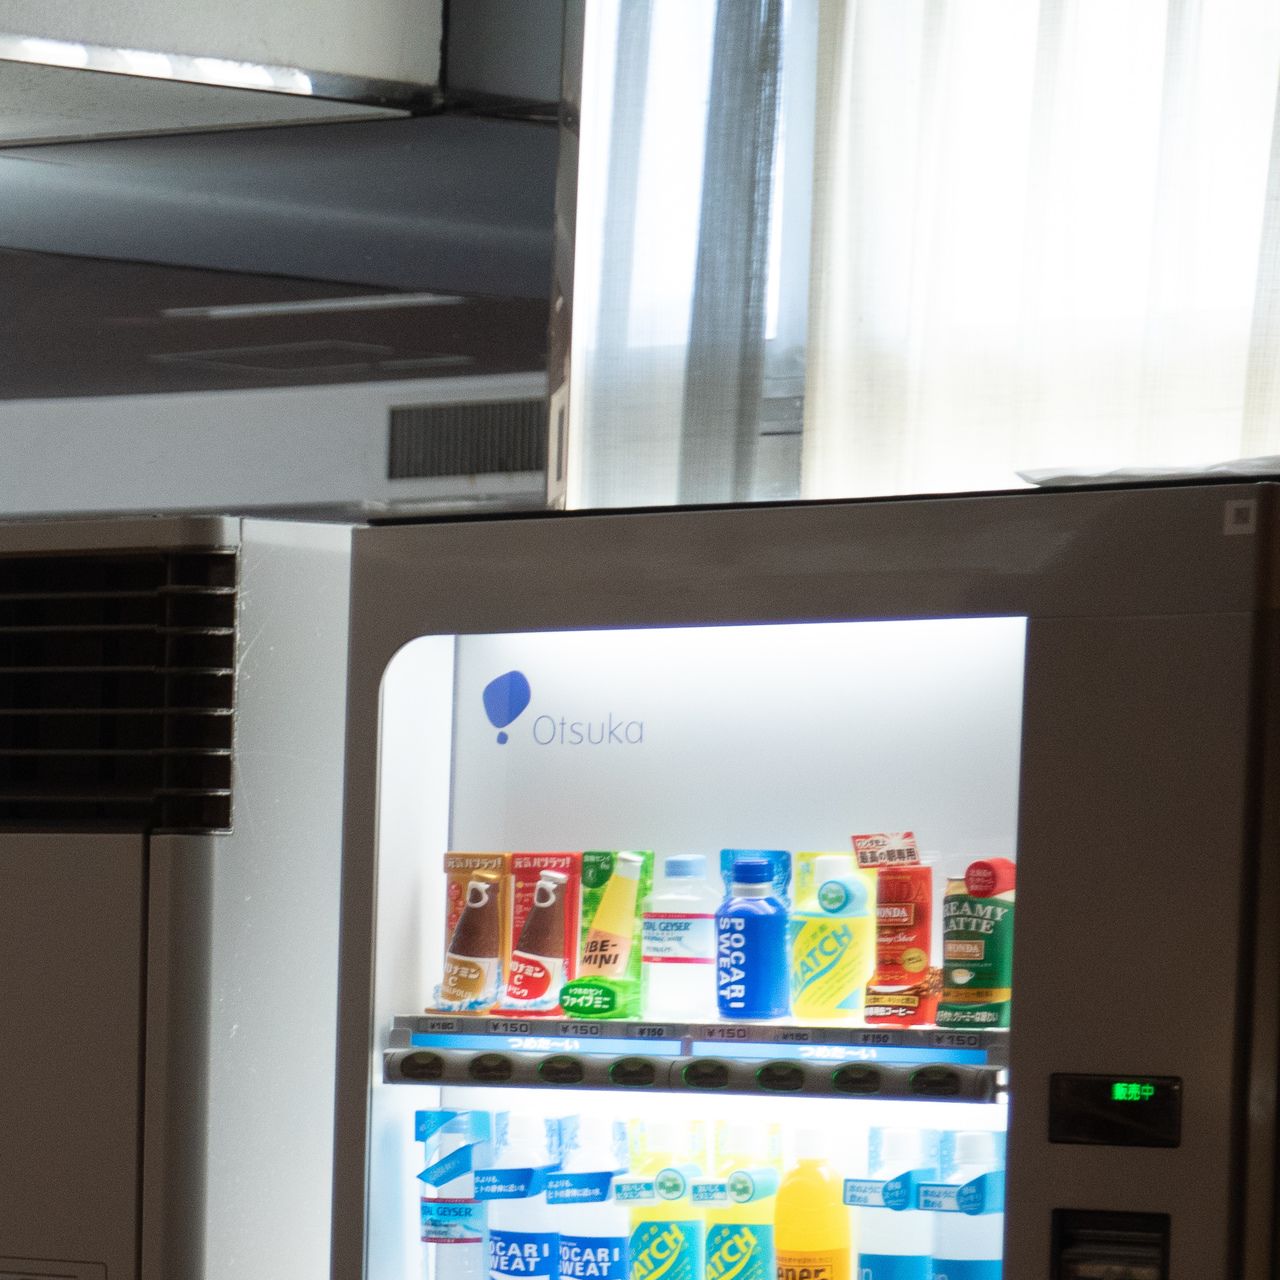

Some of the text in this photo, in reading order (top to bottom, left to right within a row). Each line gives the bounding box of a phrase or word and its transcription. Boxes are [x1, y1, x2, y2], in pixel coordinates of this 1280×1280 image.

[532, 712, 645, 746] Otsuka
[583, 938, 619, 953] IBE-
[718, 916, 732, 1000] SWEAT
[729, 917, 746, 1009] POCARI
[491, 1021, 529, 1034] ¥150
[560, 1023, 600, 1036] ¥150
[436, 1206, 473, 1218] GEYSER
[631, 1223, 686, 1280] ATCH
